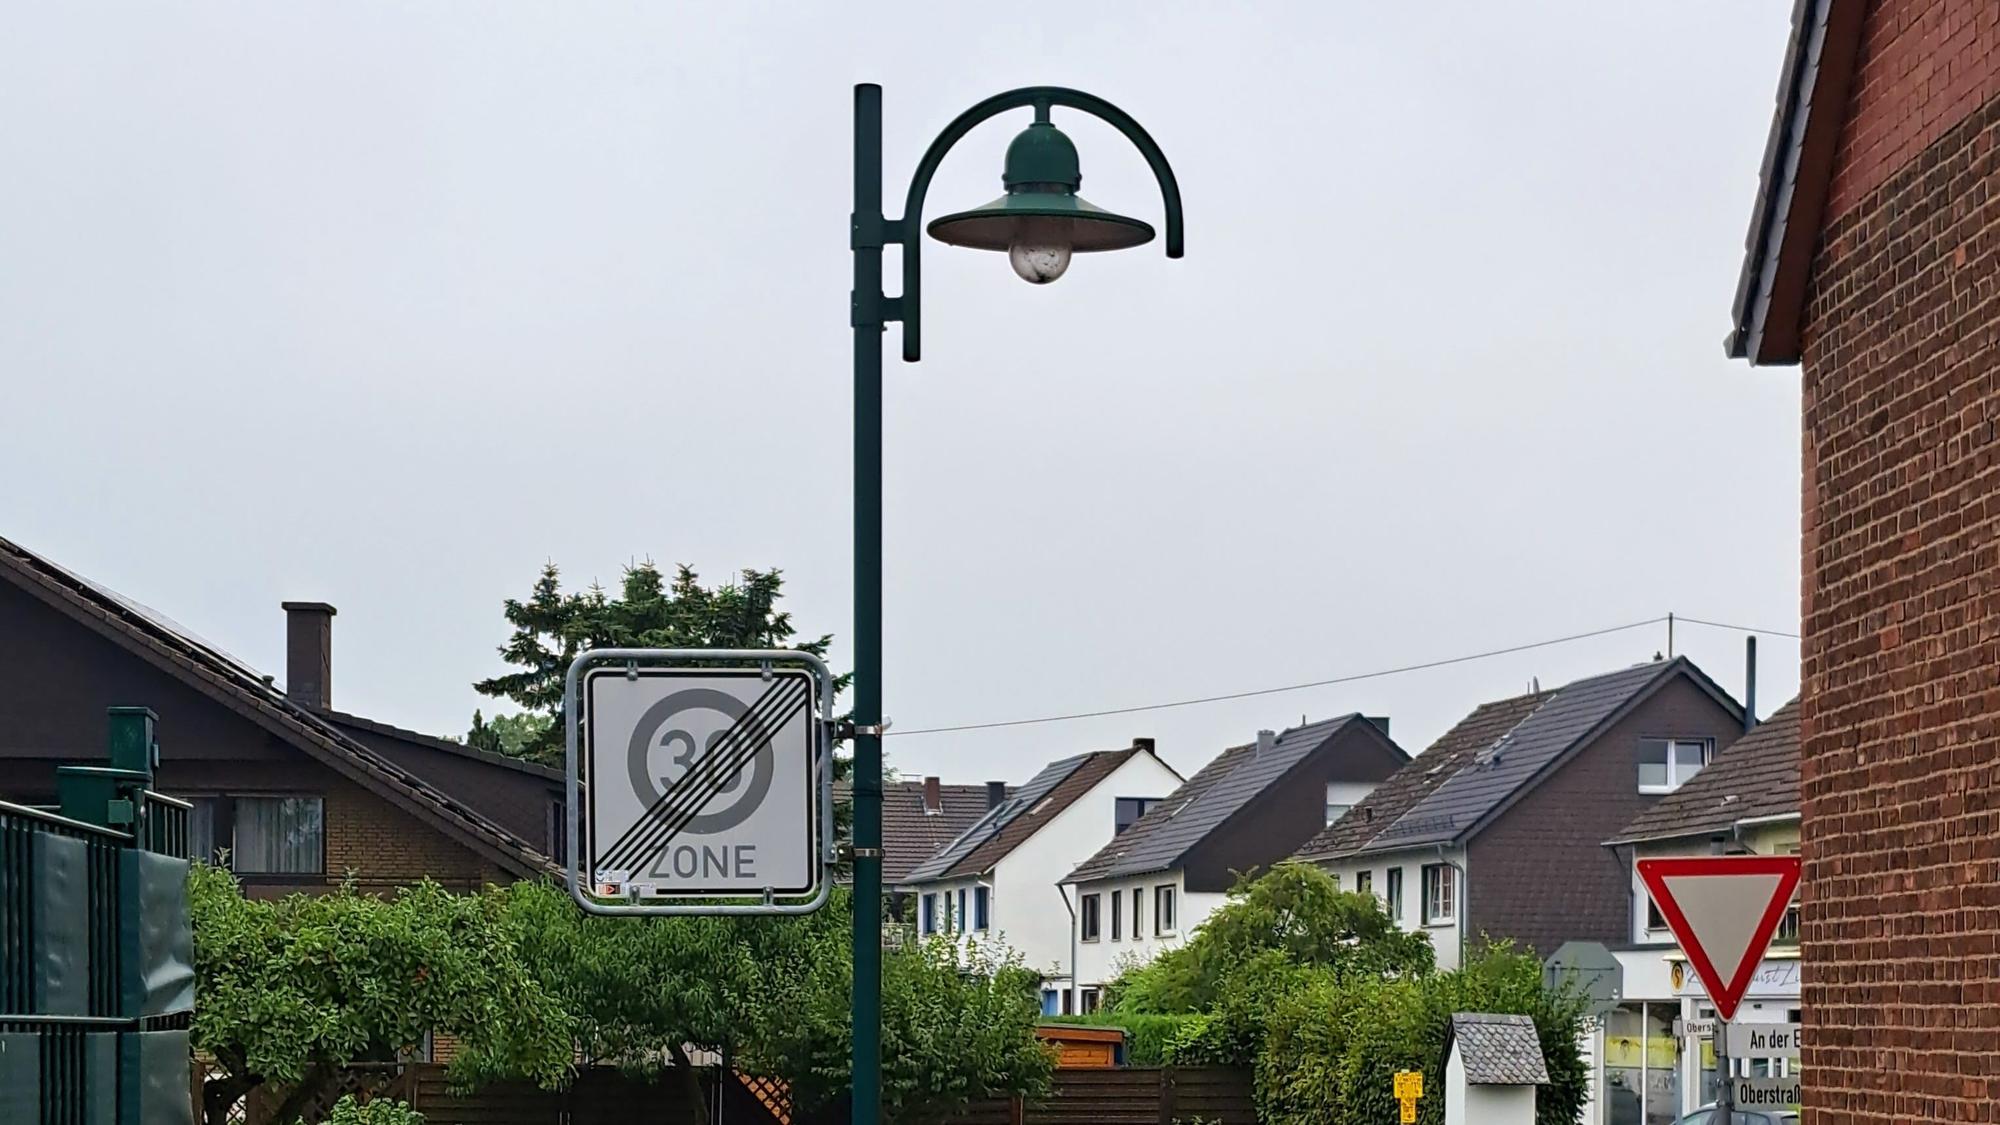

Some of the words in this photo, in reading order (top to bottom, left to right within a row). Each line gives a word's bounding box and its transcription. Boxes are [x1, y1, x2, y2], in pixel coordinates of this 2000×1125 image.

[660, 729, 742, 793] 30
[649, 845, 757, 879] ZONE
[1750, 1030, 1765, 1050] An
[1769, 1029, 1789, 1049] der
